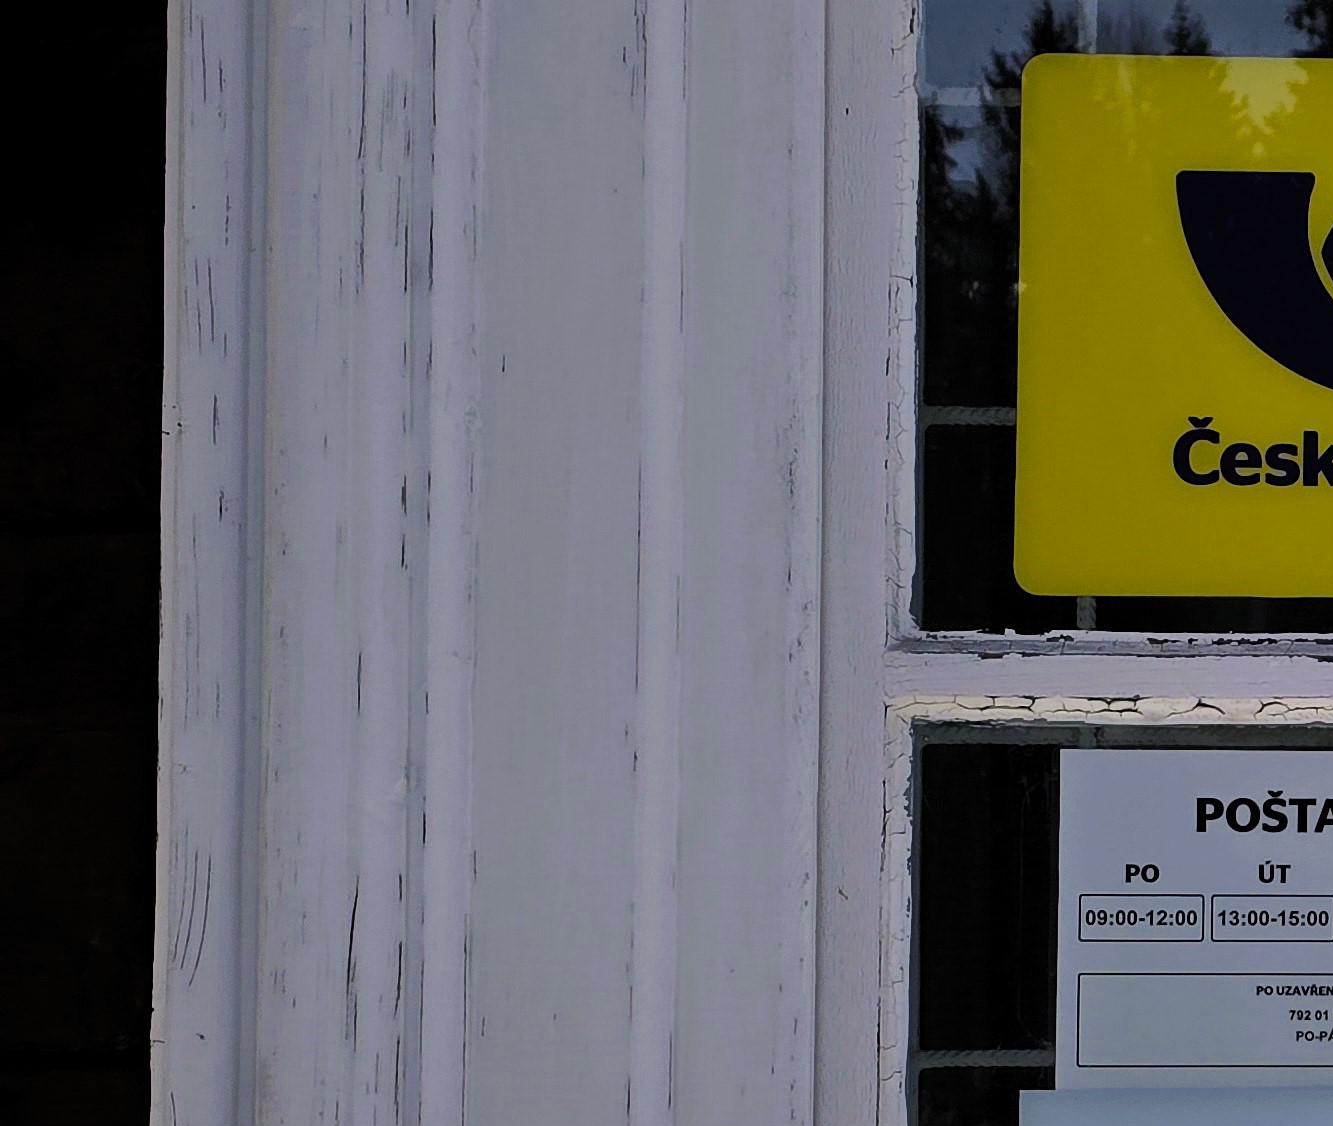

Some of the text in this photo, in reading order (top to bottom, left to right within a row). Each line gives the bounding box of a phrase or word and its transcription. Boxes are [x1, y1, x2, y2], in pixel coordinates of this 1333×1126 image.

[1125, 863, 1160, 884] PO
[1258, 860, 1292, 884] ÚT
[1085, 909, 1198, 927] 09:00-12:00
[1217, 909, 1330, 927] 13:00-15:00
[1256, 985, 1274, 996] PO
[1289, 1009, 1312, 1021] 792
[1314, 1009, 1329, 1021] 01
